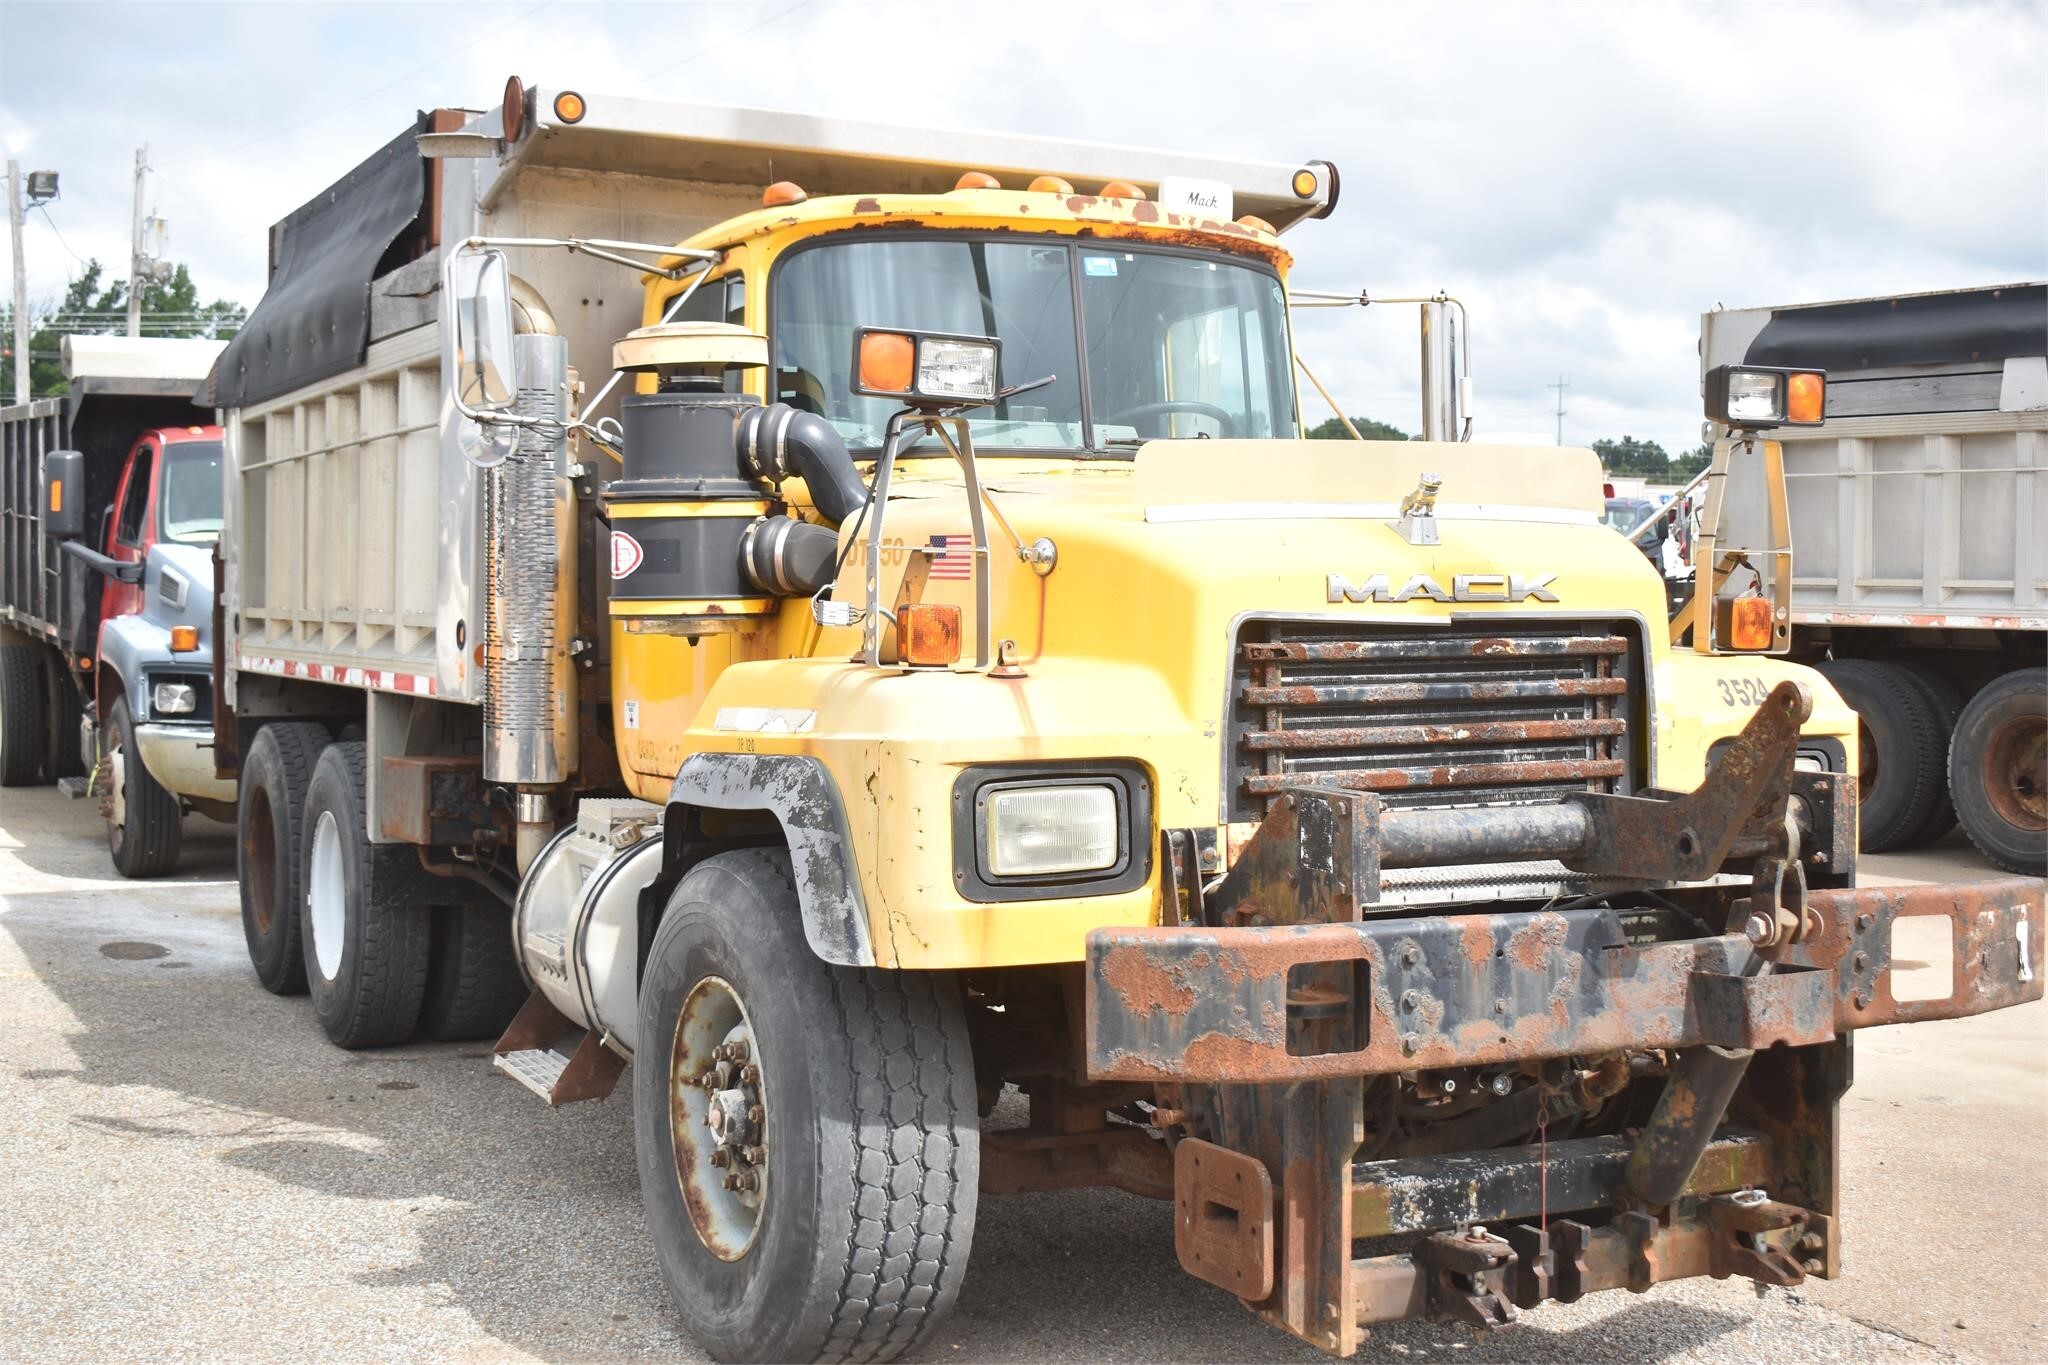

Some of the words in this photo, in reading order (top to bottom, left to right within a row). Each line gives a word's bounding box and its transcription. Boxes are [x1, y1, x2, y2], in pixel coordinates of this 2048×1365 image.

[1186, 191, 1218, 208] Mack
[1326, 574, 1560, 603] MACK
[1716, 677, 1770, 707] 3524
